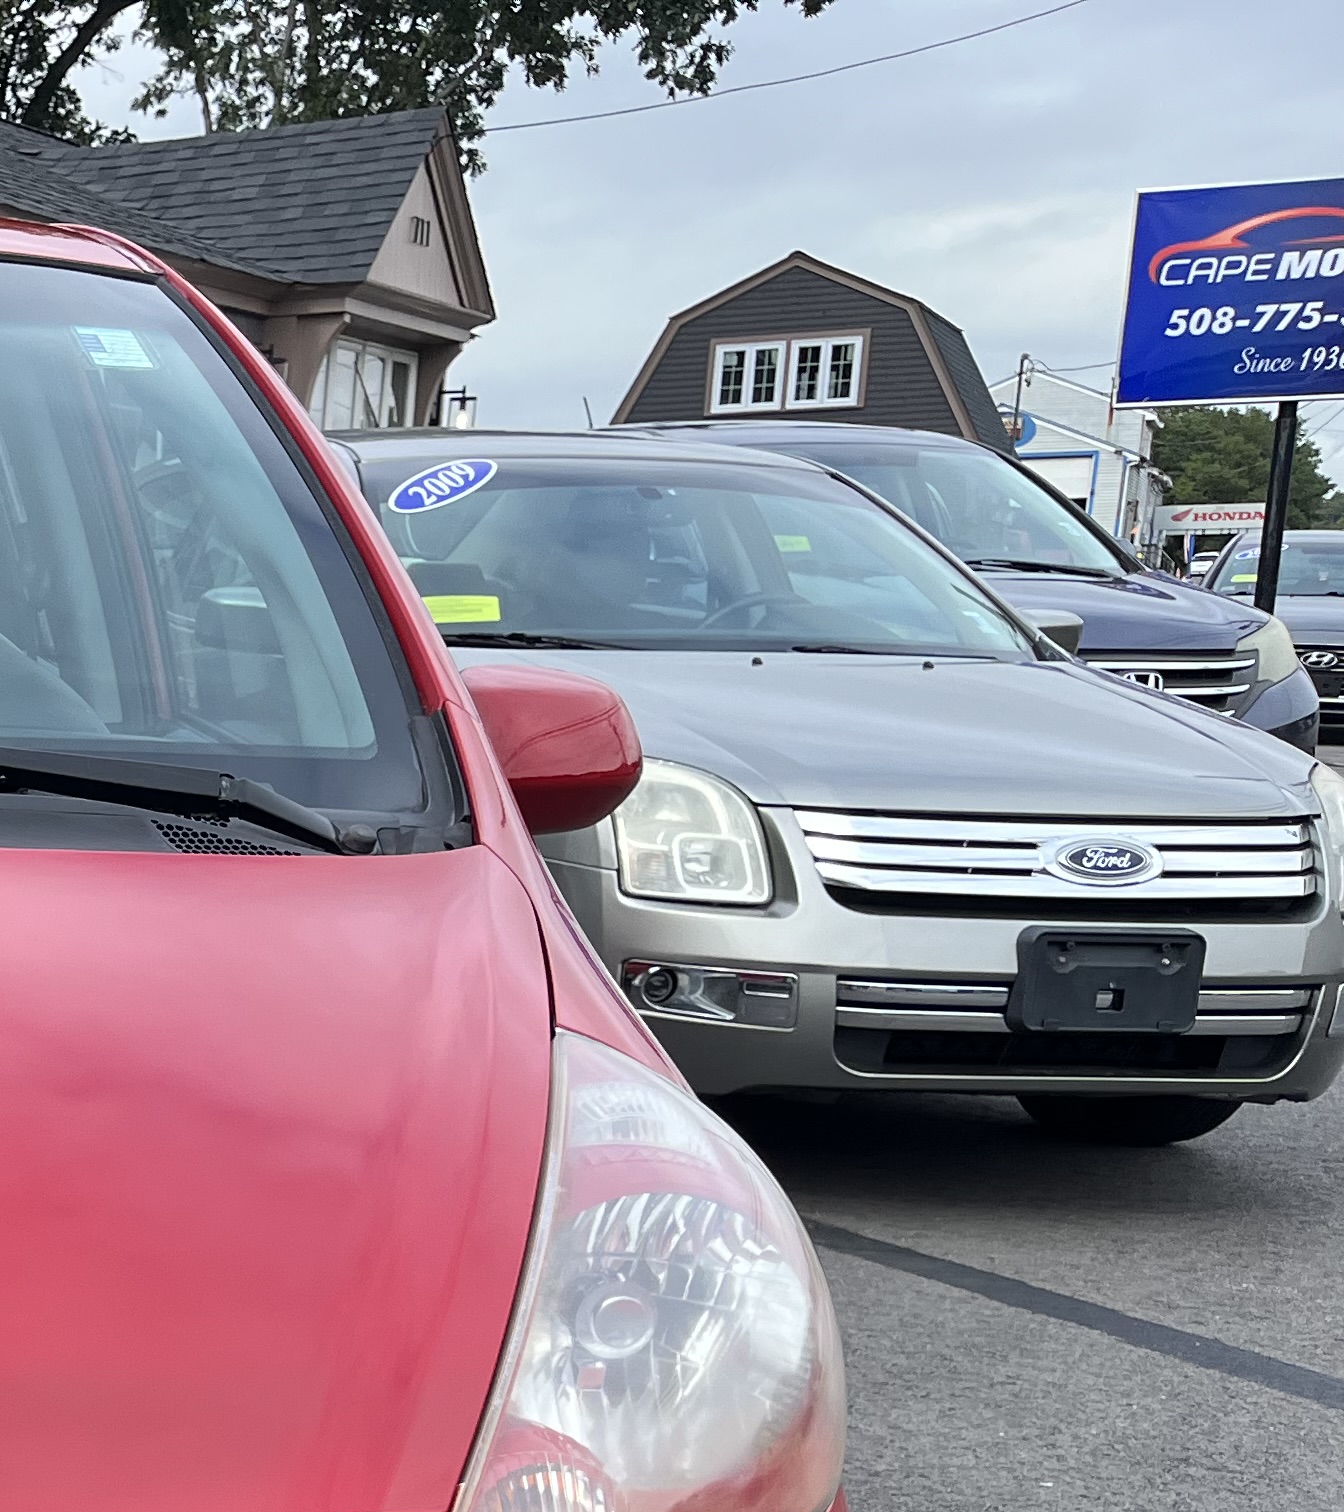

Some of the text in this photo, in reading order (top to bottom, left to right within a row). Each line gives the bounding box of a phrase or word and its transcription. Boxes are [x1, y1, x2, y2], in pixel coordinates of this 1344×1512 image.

[1159, 252, 1275, 287] CAPE
[1164, 301, 1344, 338] 508-775-
[1233, 346, 1295, 375] Since
[407, 463, 476, 506] 2009
[1192, 511, 1266, 522] HONDA
[1082, 847, 1132, 868] Ford
